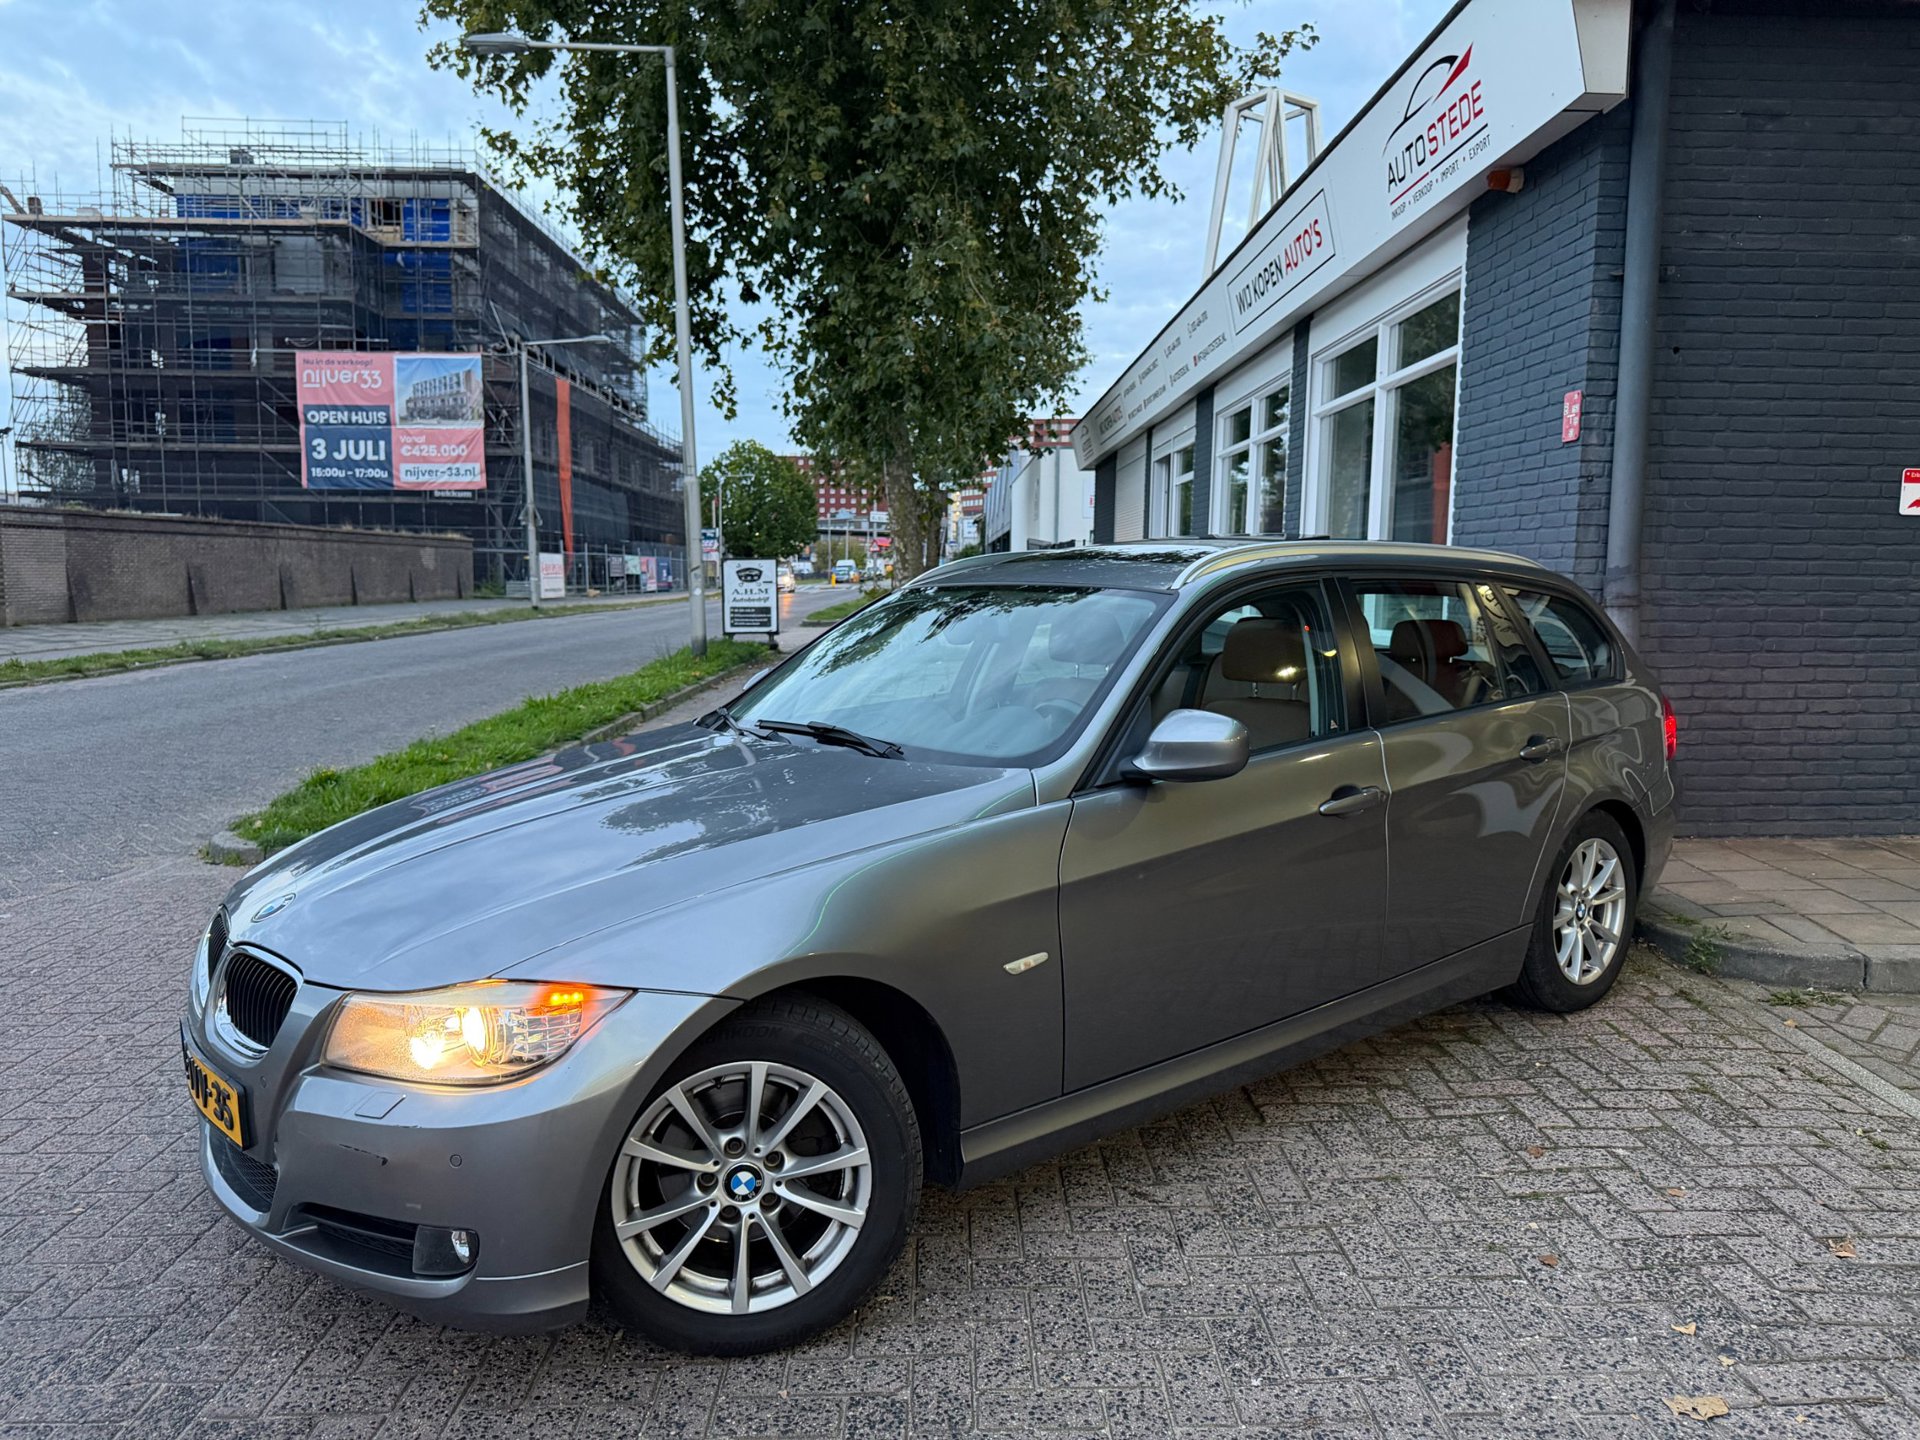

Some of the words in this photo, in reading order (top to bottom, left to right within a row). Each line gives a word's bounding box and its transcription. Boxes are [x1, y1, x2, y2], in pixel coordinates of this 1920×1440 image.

[1387, 79, 1484, 193] AUTOSTEDE
[1440, 158, 1460, 183] IMPORT
[1468, 134, 1492, 161] EXPORT
[1235, 284, 1252, 315] WIJ
[1252, 254, 1285, 303] KOPEN
[1284, 218, 1323, 275] AUTO'S
[303, 368, 382, 389] nijver33
[307, 410, 348, 424] OPEN
[351, 410, 388, 424] HUIS
[311, 437, 327, 460] 3
[332, 439, 386, 461] JULI
[401, 444, 468, 457] €425.000
[311, 467, 346, 478] 15:00u
[355, 467, 389, 479] 17:00u
[404, 466, 476, 480] nijver-33.nl
